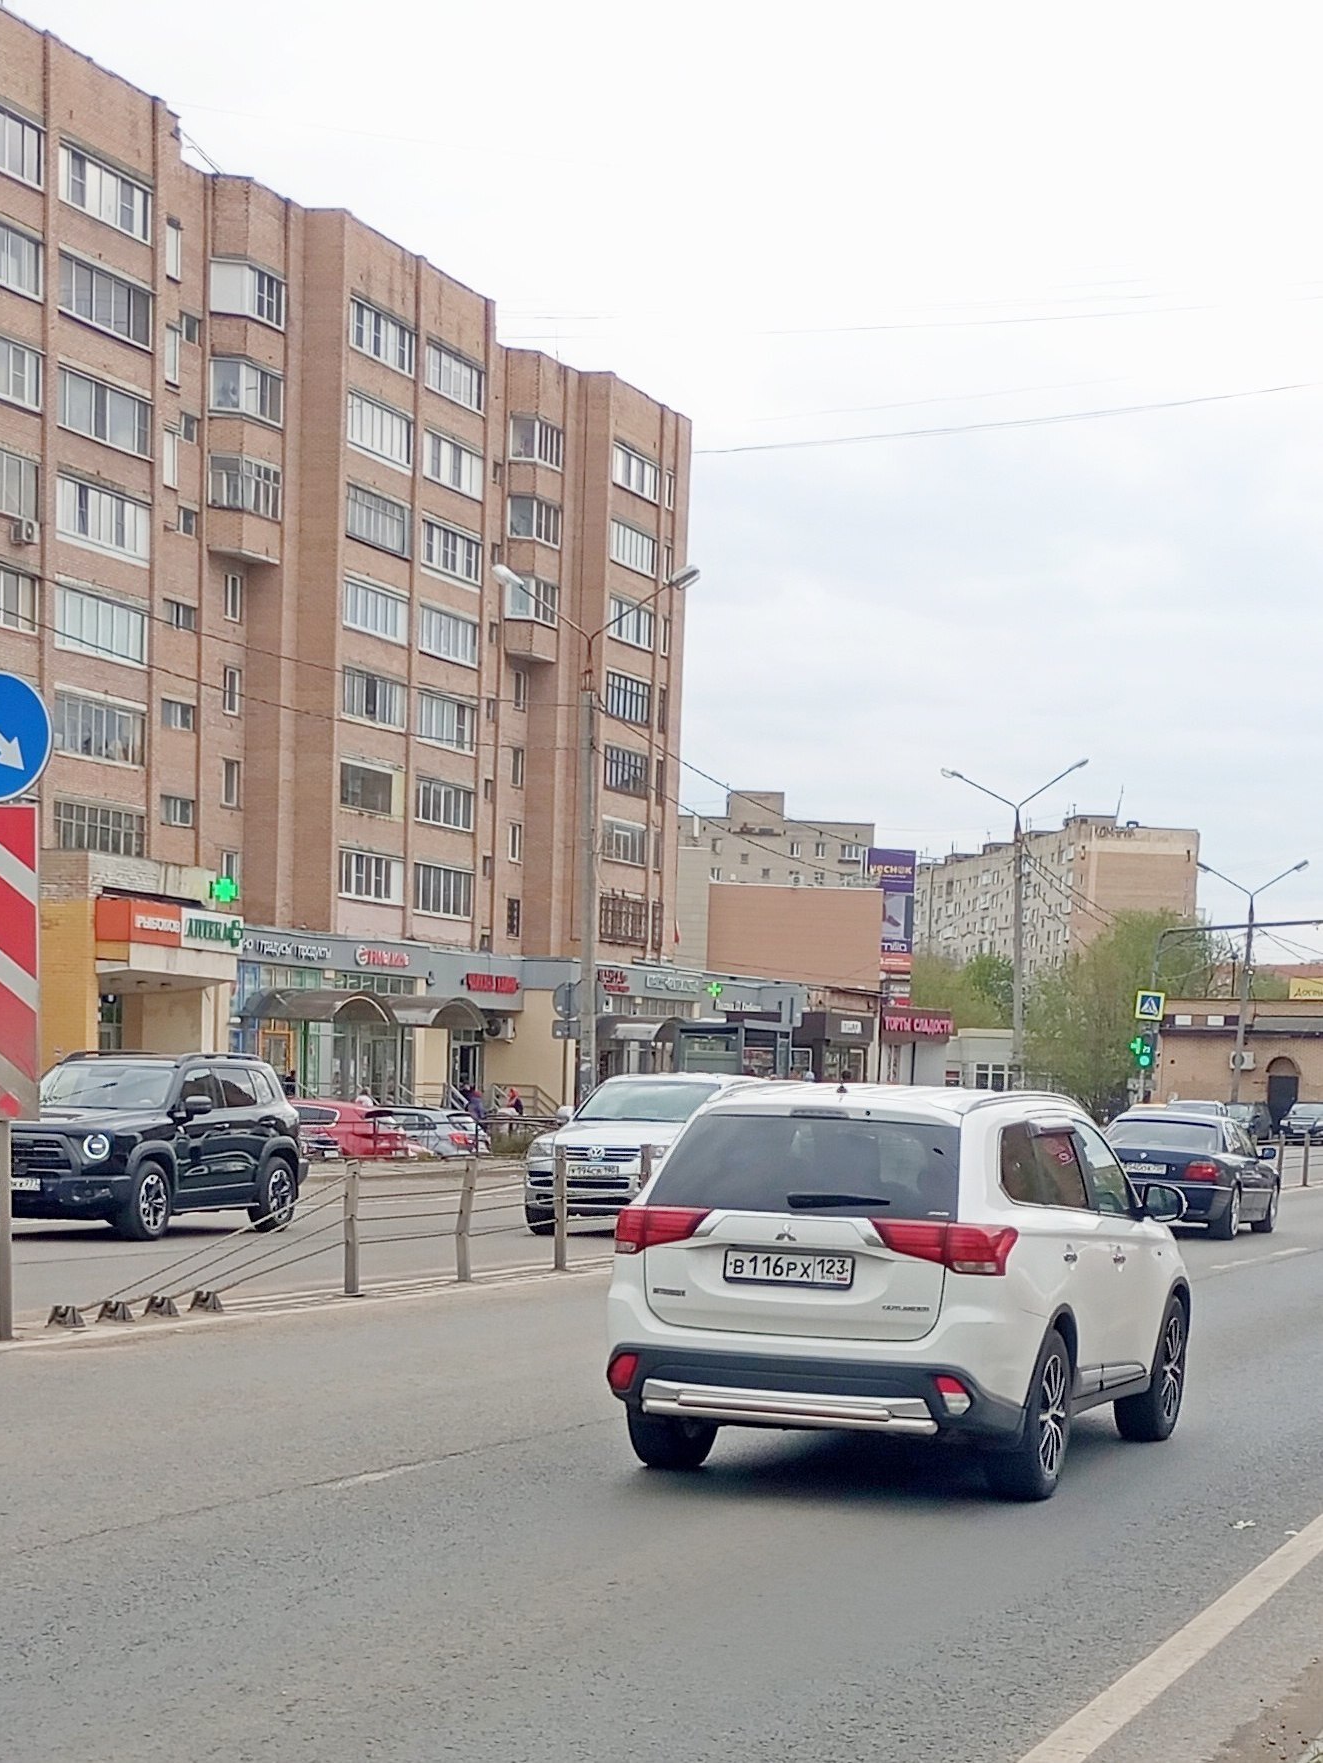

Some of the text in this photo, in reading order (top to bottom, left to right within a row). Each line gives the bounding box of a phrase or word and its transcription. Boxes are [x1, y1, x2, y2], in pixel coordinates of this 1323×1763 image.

[884, 1016, 954, 1035] ТОРТЫ СЛАДОСТИ
[816, 1258, 846, 1275] 123
